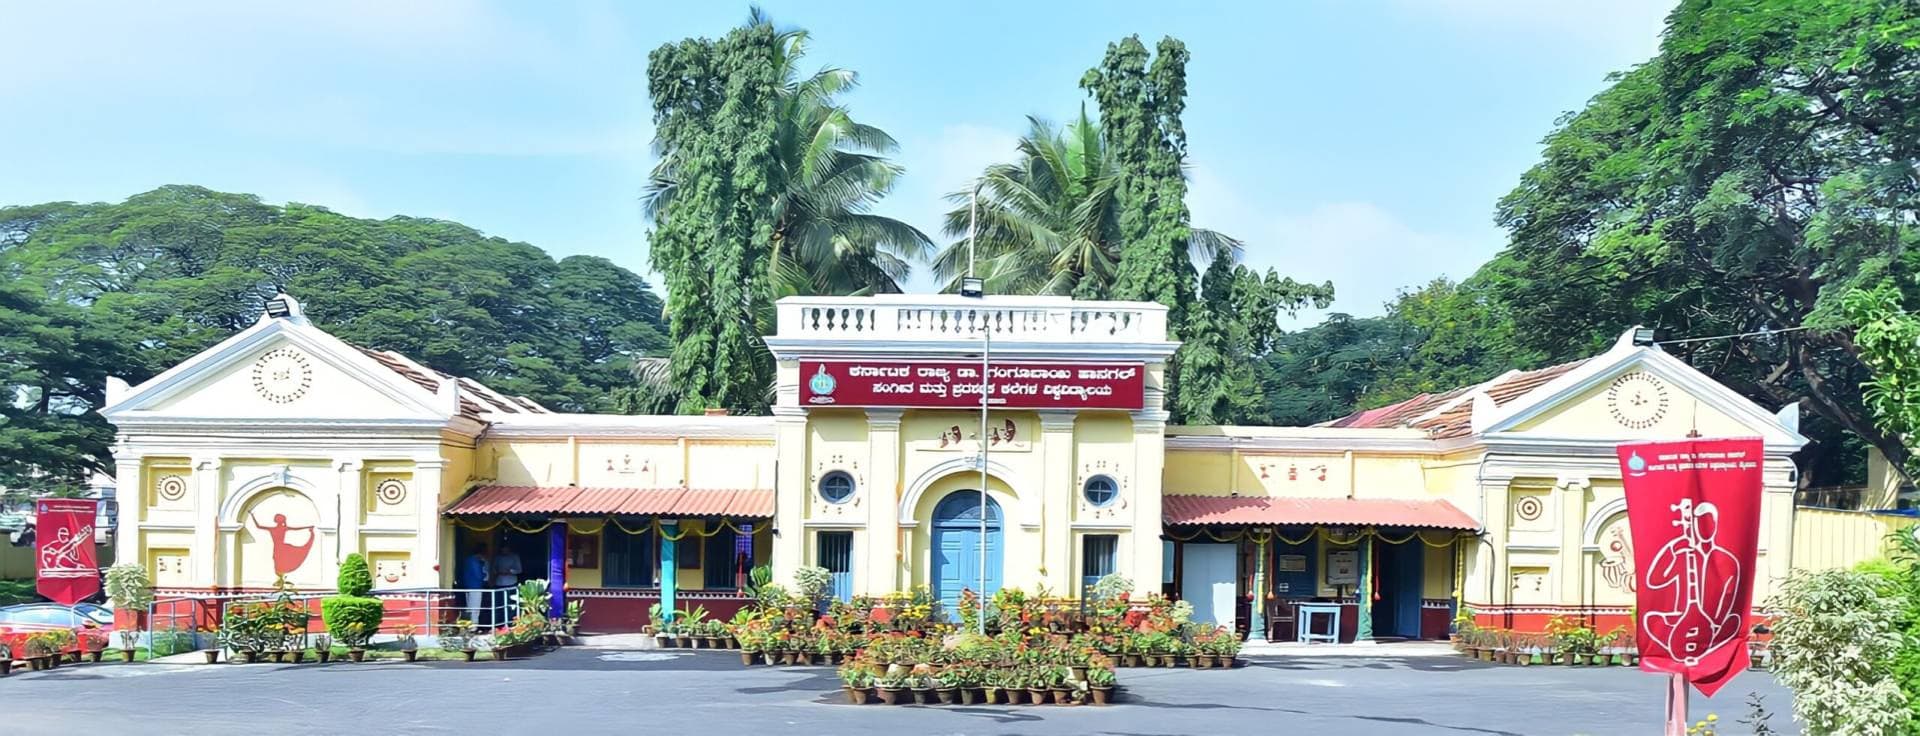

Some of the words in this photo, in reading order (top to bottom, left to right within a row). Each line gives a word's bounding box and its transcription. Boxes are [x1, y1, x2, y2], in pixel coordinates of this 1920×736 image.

[849, 366, 910, 377] ಕರ್ನಾಟಕ
[917, 368, 950, 382] ರಾಜ್ಯ
[957, 368, 979, 377] ಡಾ.
[920, 383, 948, 397] ಮತ್ತು
